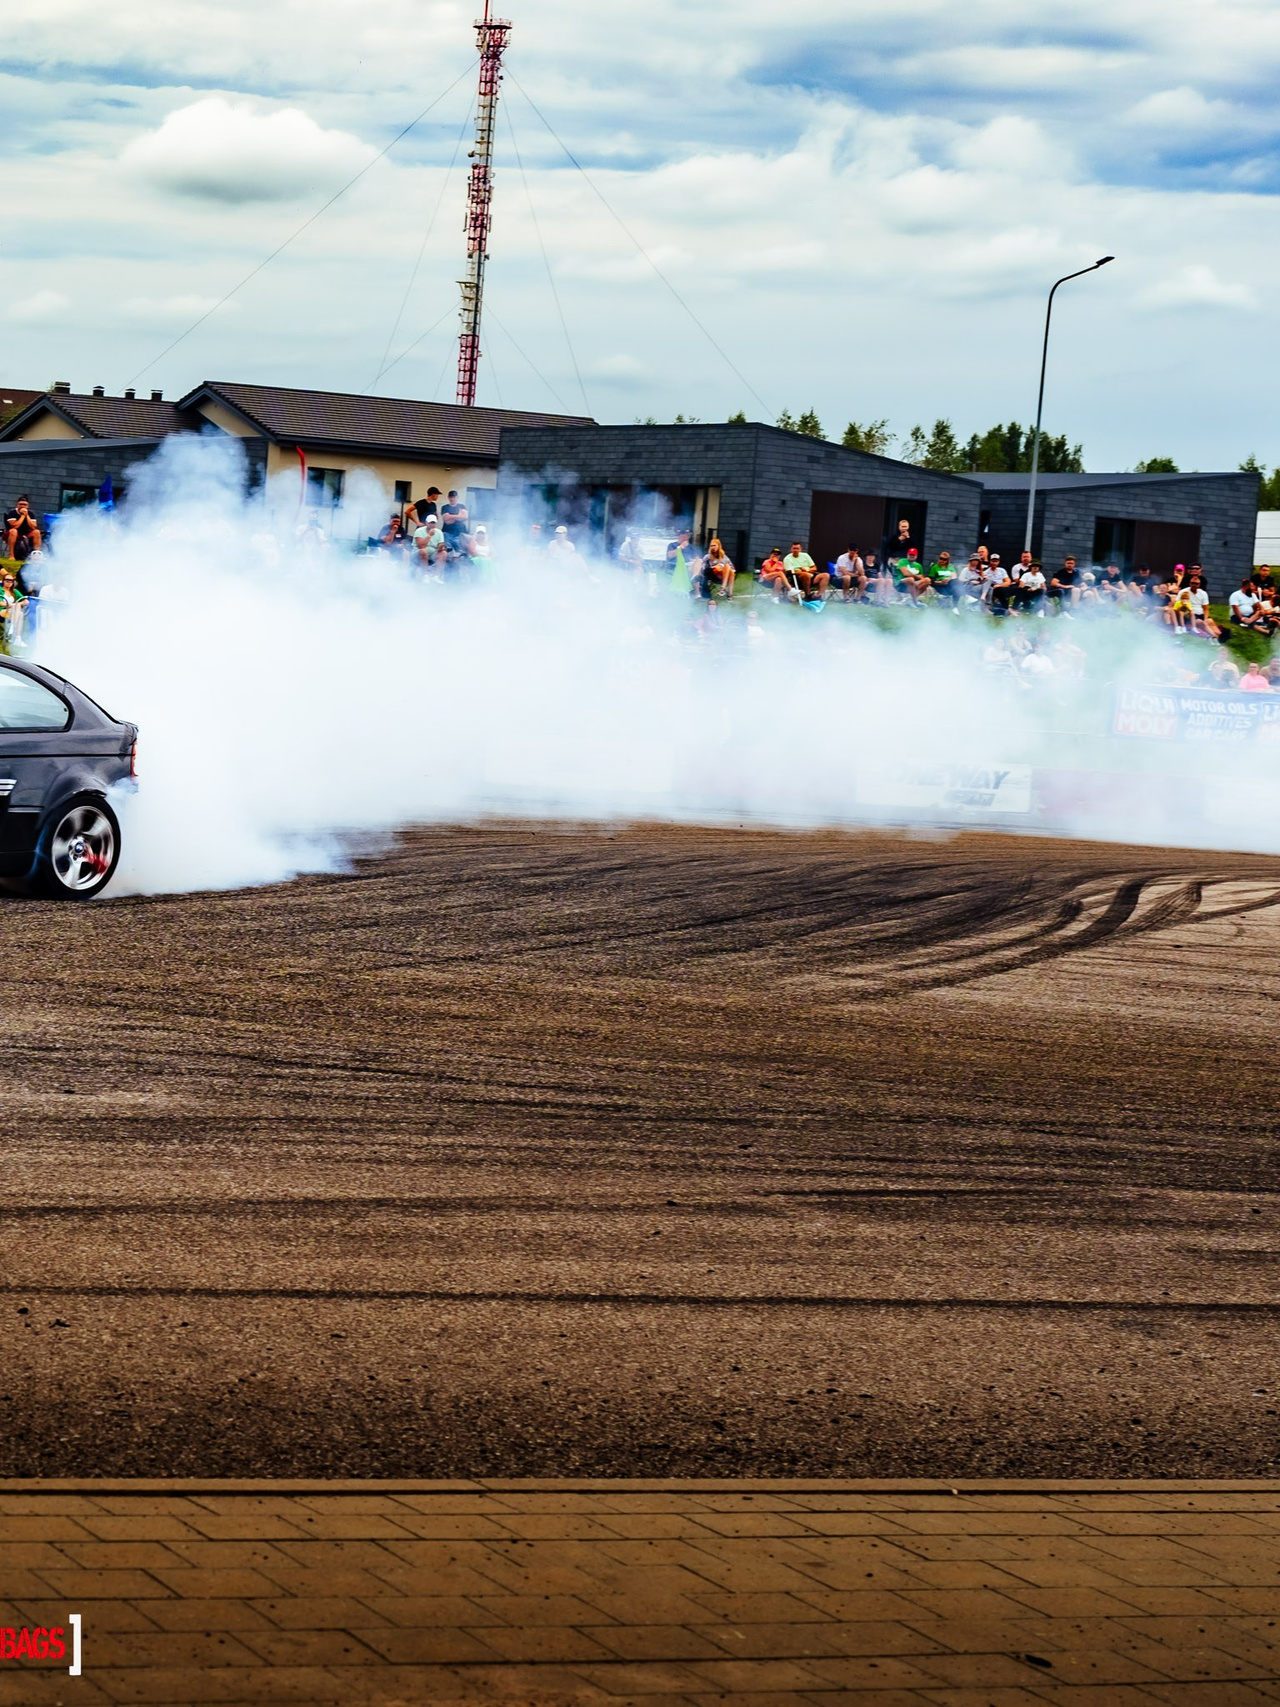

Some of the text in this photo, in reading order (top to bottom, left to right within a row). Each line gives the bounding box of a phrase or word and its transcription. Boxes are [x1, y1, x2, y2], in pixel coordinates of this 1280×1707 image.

[1121, 690, 1175, 715] LIQUI
[1181, 698, 1226, 714] MOTOR
[1227, 701, 1258, 716] OILS
[1118, 713, 1177, 736] MOLY
[1186, 713, 1252, 729] ADDITIVES
